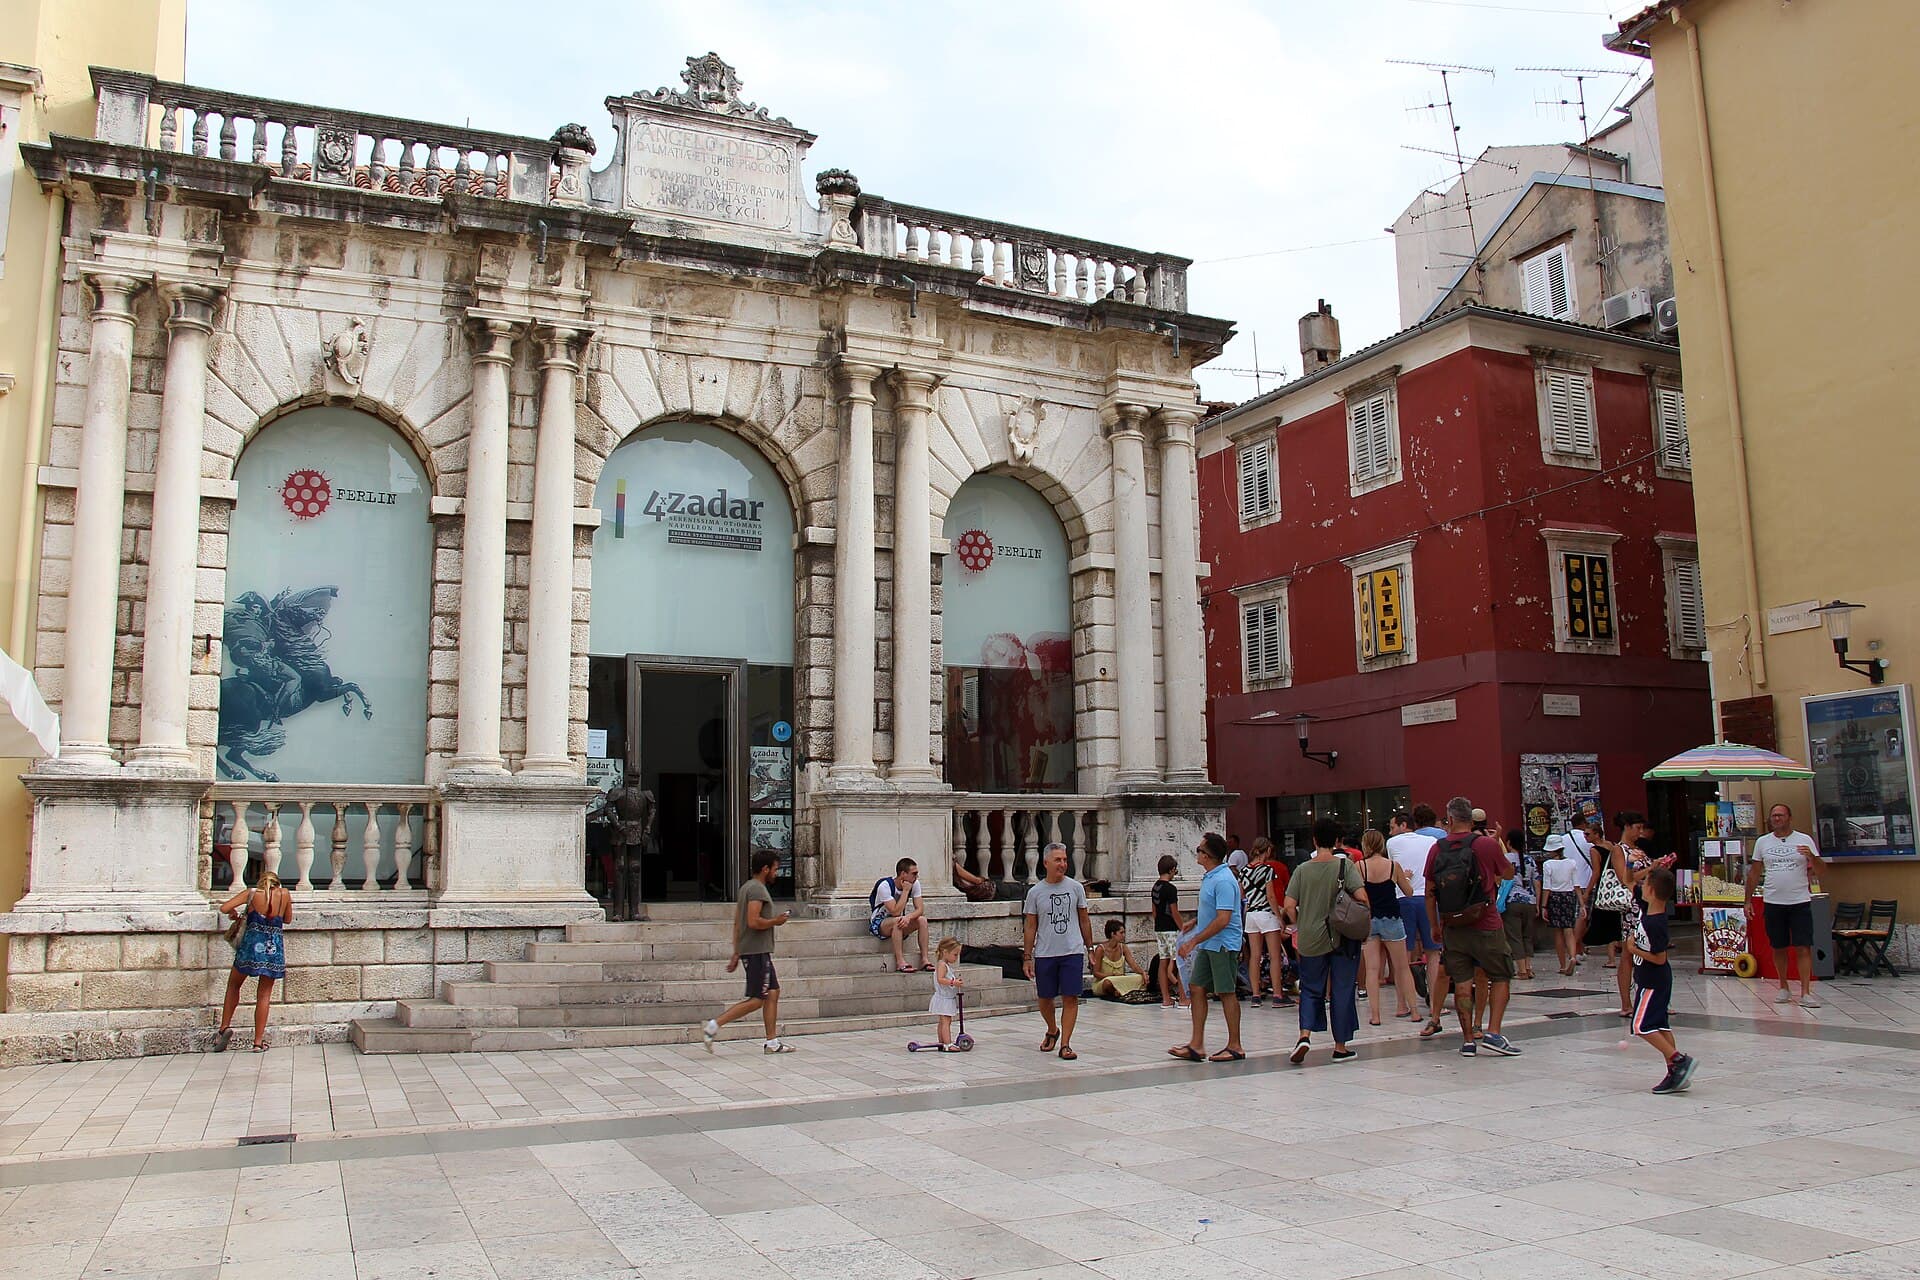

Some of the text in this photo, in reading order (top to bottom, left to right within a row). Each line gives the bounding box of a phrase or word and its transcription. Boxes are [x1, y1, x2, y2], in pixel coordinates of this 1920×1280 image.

[704, 165, 720, 177] OB
[336, 488, 397, 505] FERLIN
[997, 545, 1042, 559] FERLIN
[1569, 559, 1585, 633] FOTO
[1593, 560, 1608, 634] ATELJE
[1361, 582, 1370, 652] FOTO
[1380, 575, 1398, 646] ATELJE
[1707, 928, 1744, 945] FRESH
[1711, 949, 1738, 959] POPCOR
